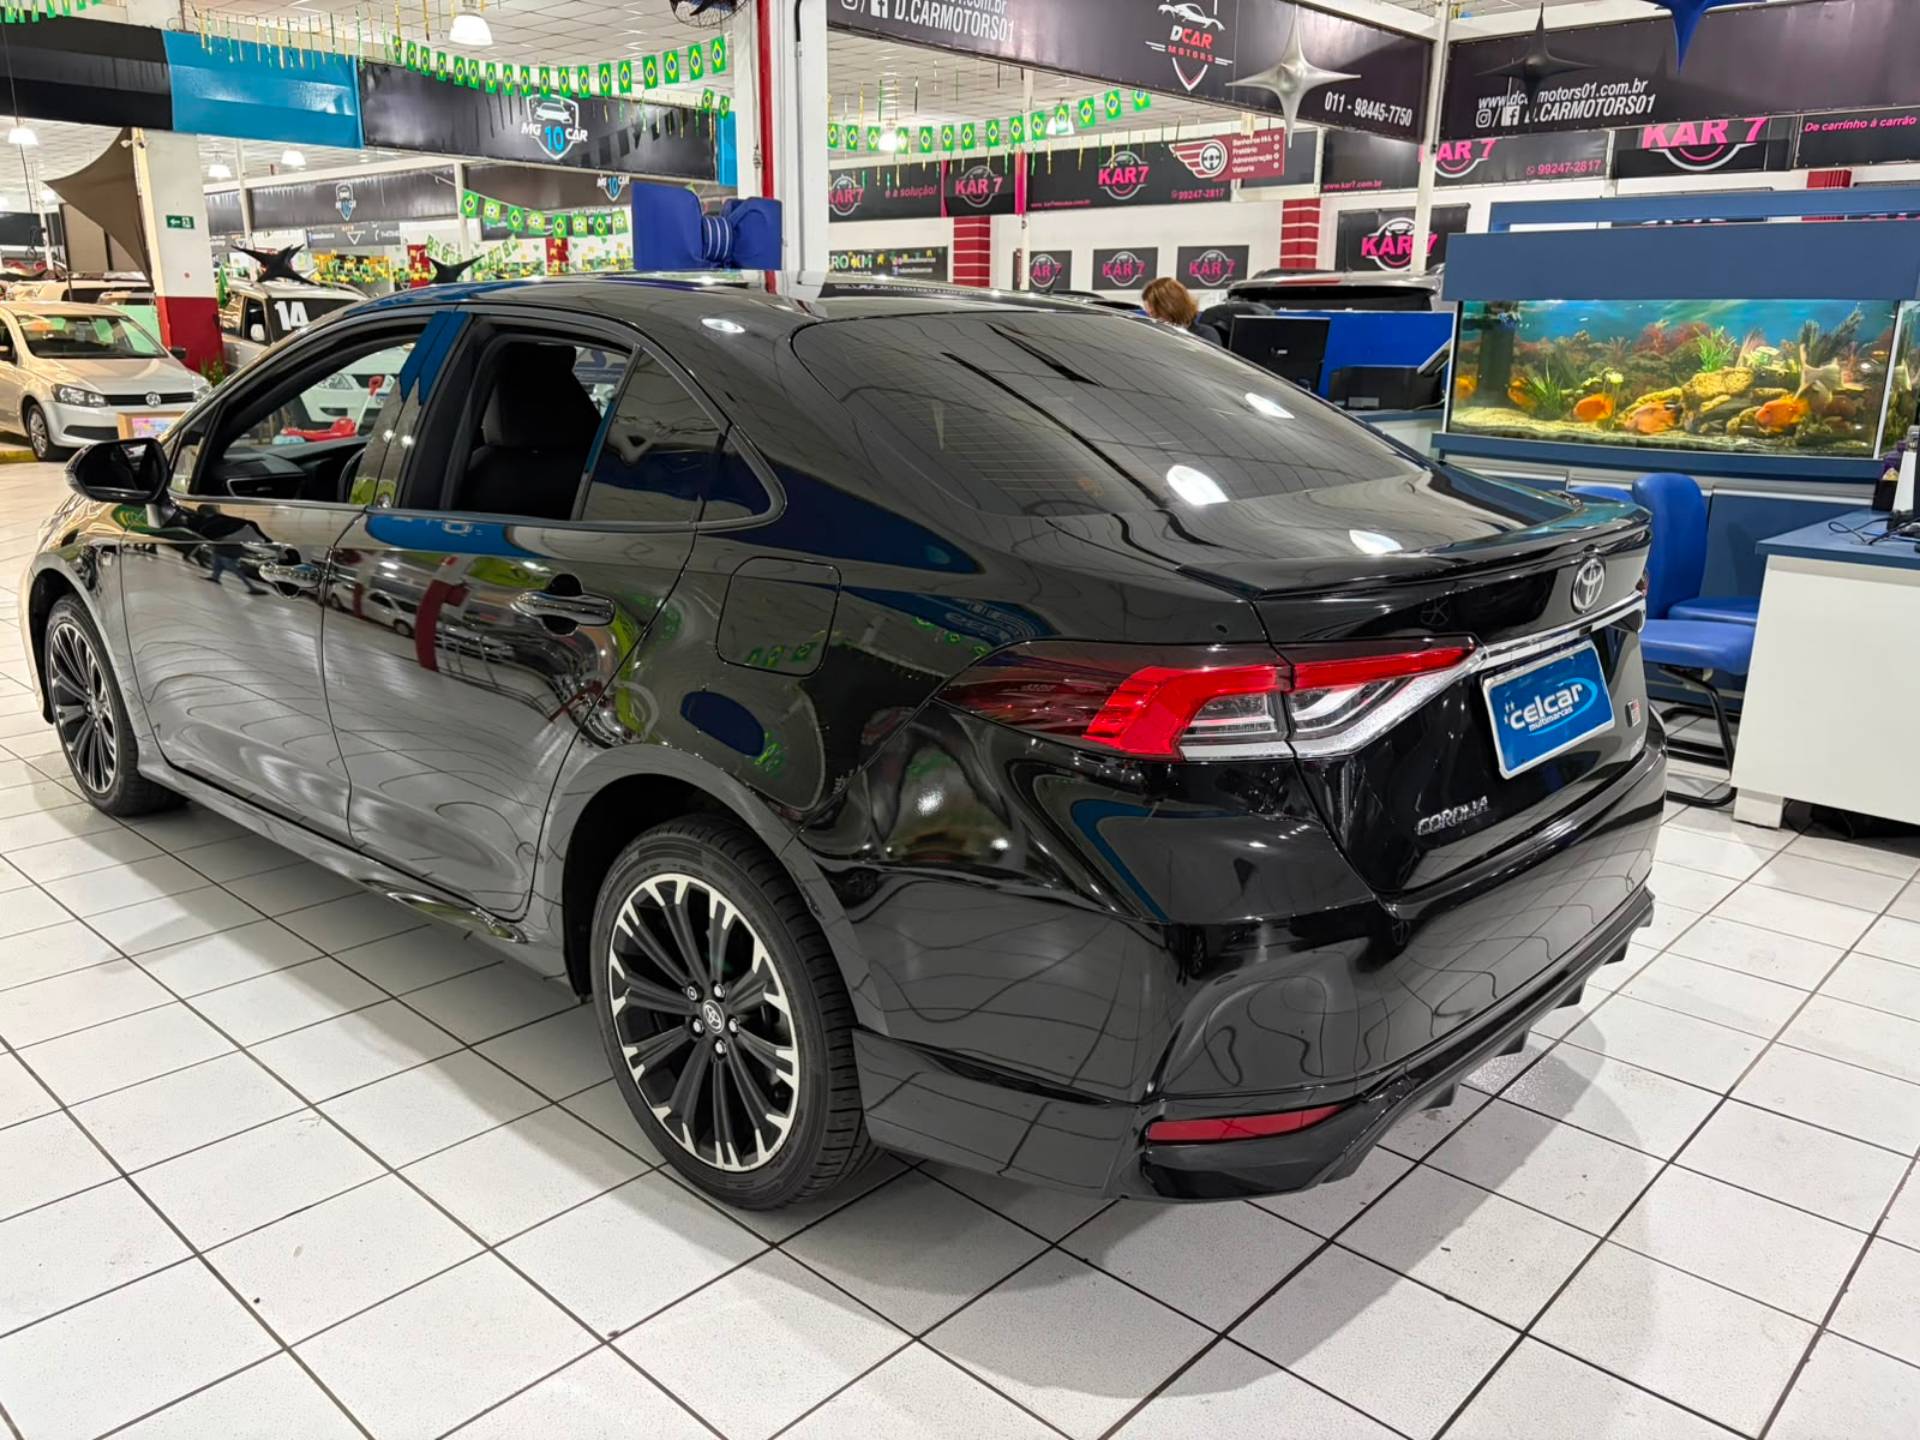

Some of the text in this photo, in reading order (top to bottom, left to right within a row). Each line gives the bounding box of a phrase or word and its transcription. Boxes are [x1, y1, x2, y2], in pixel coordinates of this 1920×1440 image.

[894, 0, 1015, 42] D.CARMOTORS01
[1169, 25, 1213, 49] DCAR
[1168, 44, 1214, 62] MOTORS
[1478, 77, 1648, 109] www.dcmotors01.com.br
[1325, 91, 1345, 113] 011
[1354, 98, 1413, 127] 98445-7750
[1641, 117, 1769, 149] KAR 7
[1804, 122, 1819, 132] De
[1880, 115, 1917, 126] carrão
[521, 122, 588, 153] MG 10 CAR
[1481, 138, 1496, 160] 7
[1098, 166, 1149, 184] KAR 7
[1538, 159, 1601, 175] 99247-2817
[856, 187, 864, 205] 7
[955, 177, 1003, 195] KAR 7
[1103, 263, 1133, 277] KAR
[1189, 261, 1222, 275] KAR
[274, 301, 310, 331] 14
[1509, 683, 1583, 730] celcar
[1528, 706, 1574, 732] multimarcas
